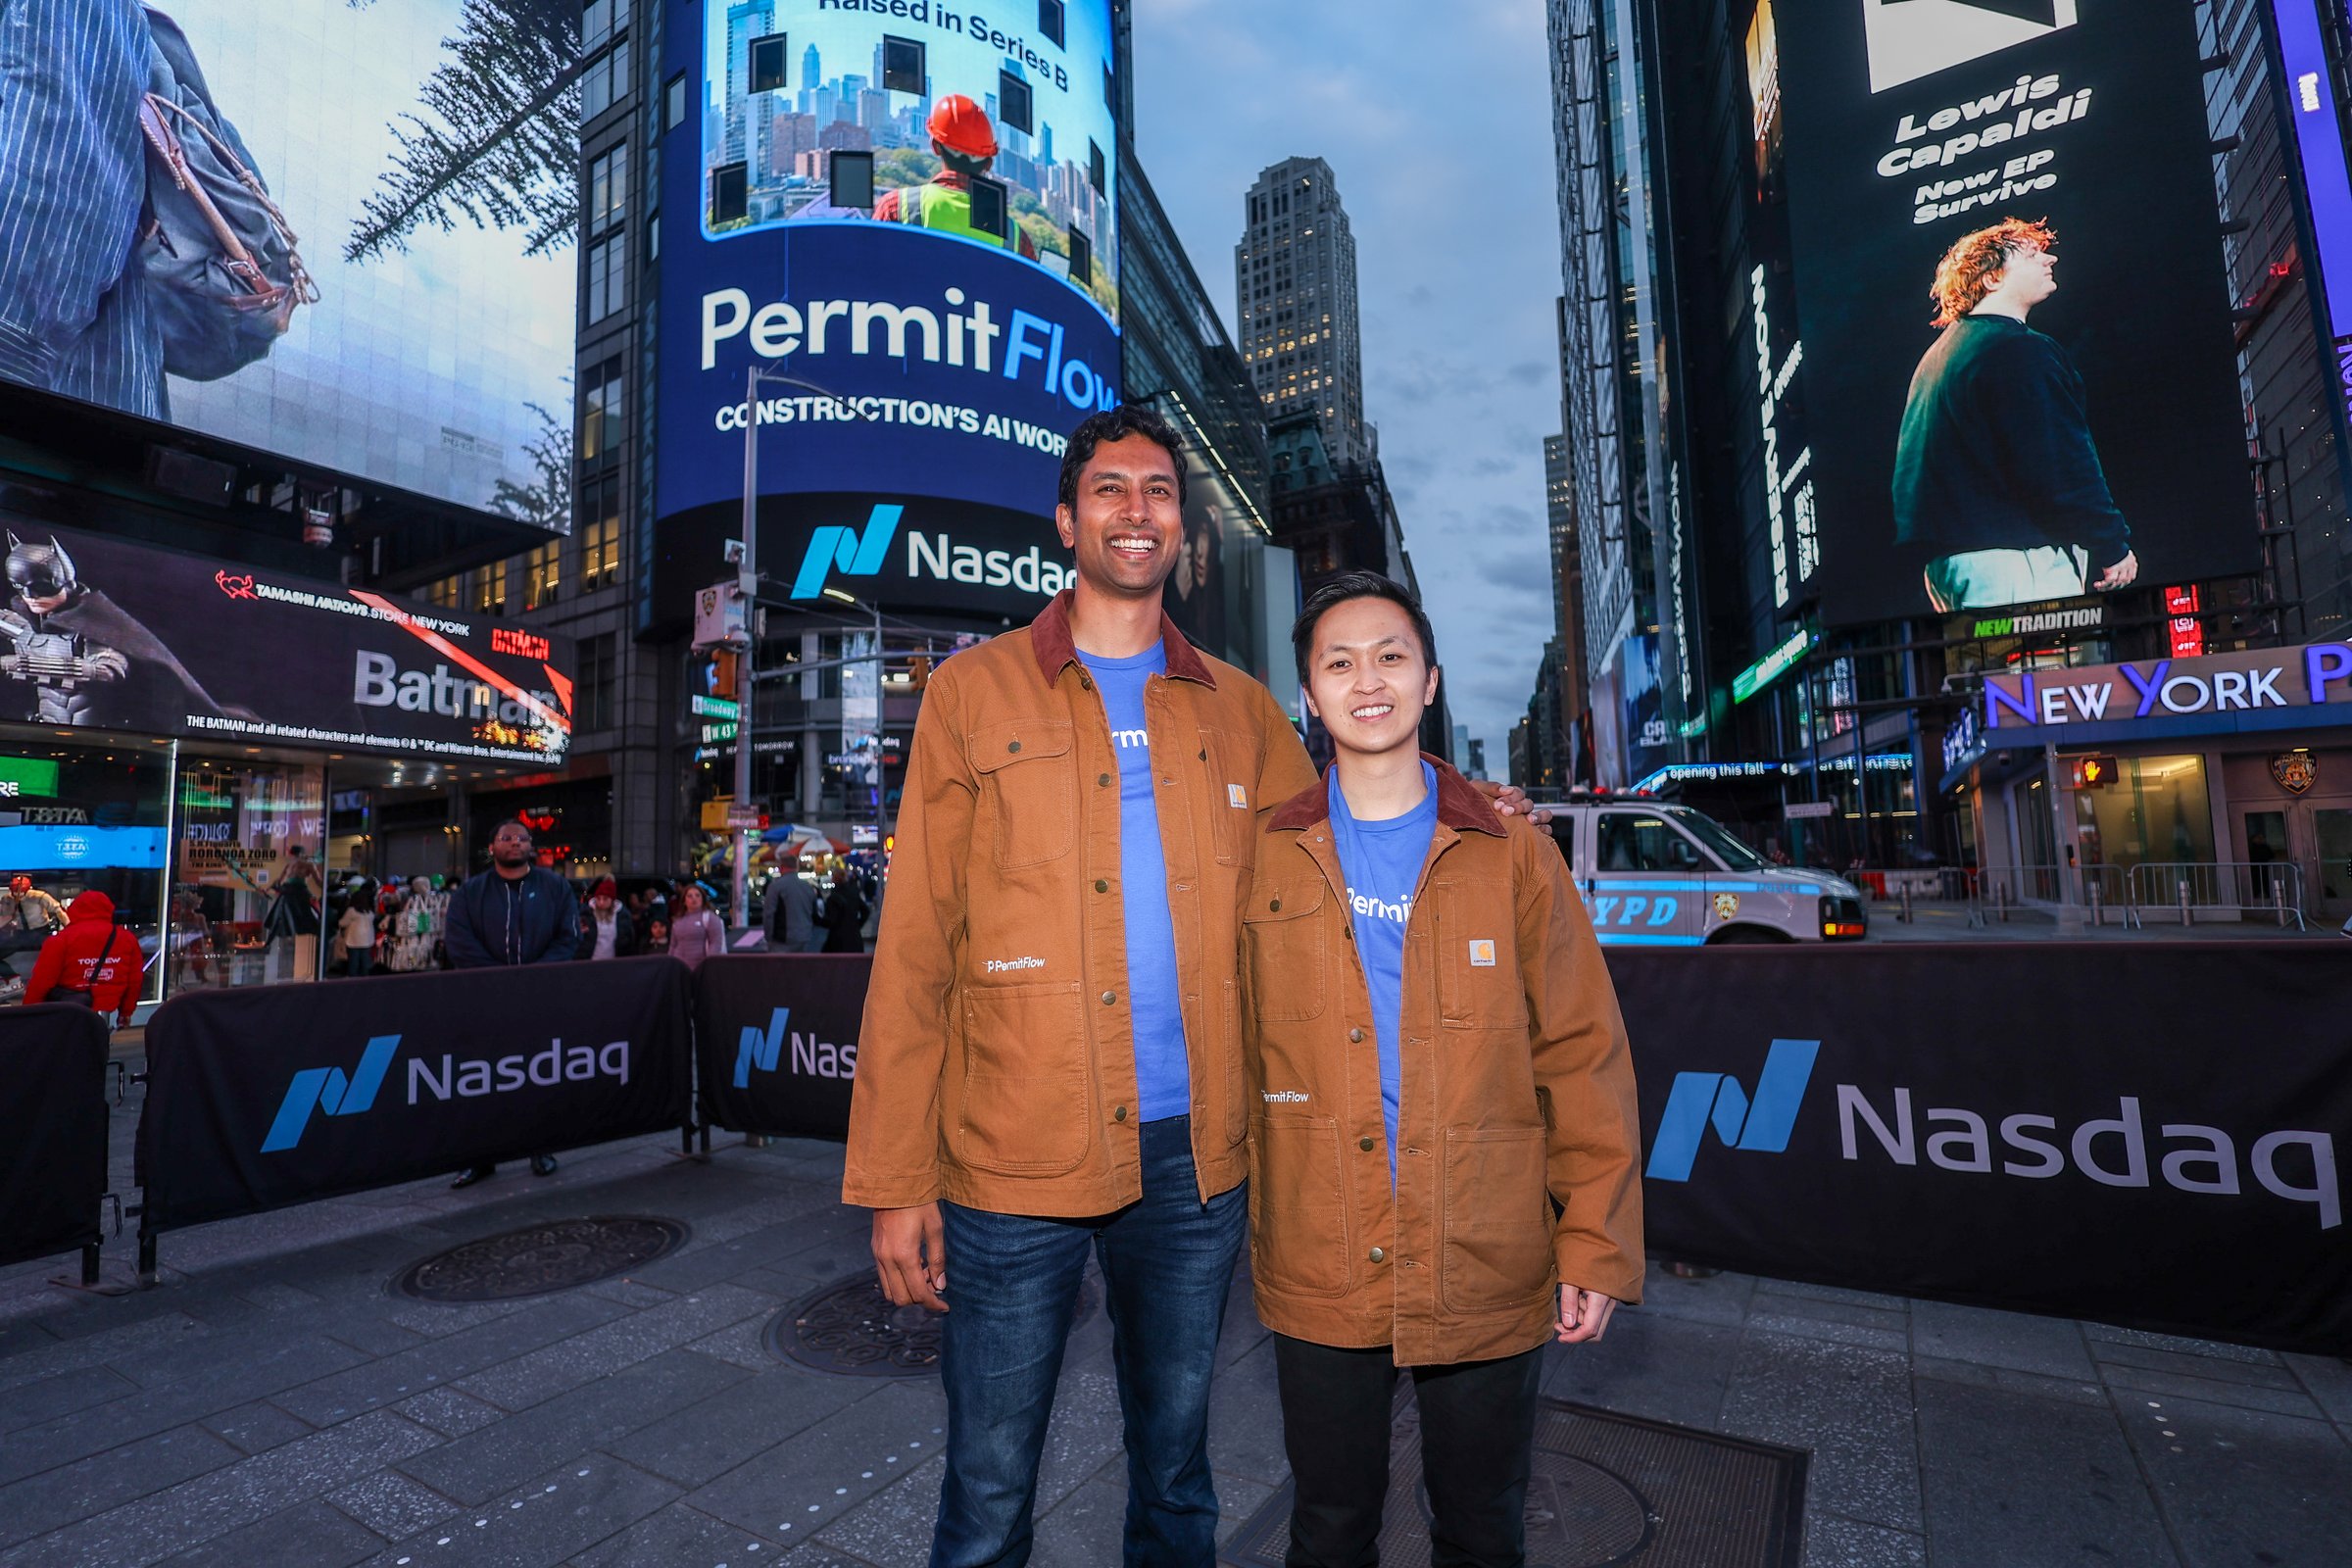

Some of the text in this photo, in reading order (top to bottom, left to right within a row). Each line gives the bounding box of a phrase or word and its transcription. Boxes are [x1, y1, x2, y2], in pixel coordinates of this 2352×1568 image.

[936, 4, 962, 33] in
[969, 16, 1051, 79] Series
[1055, 63, 1069, 93] B
[1876, 88, 2093, 177] Capaldi
[1894, 74, 2060, 144] Lewis
[1913, 173, 2058, 224] Survive
[1914, 149, 2055, 206] New EP
[982, 414, 1011, 441] AI
[1012, 419, 1069, 459] WOR
[256, 583, 315, 607] TAMASHII
[370, 608, 410, 625] STORE
[411, 614, 437, 630] NEW
[439, 619, 470, 637] YORK
[353, 649, 558, 725] Batman
[703, 700, 736, 720] Broadway
[186, 714, 206, 728] THE
[207, 716, 246, 732] BATMAN
[246, 722, 264, 734] and
[265, 723, 276, 735] all
[277, 725, 308, 738] related
[308, 729, 349, 743] characters
[349, 732, 366, 744] and
[366, 734, 400, 748] elements
[435, 742, 449, 753] and
[449, 742, 473, 755] Warner
[711, 726, 719, 740] W
[721, 724, 731, 738] 43
[1670, 766, 1717, 782] opening
[1719, 762, 1742, 777] this
[1744, 760, 1765, 776] fall
[1347, 887, 1414, 923] Permi
[1585, 896, 1679, 927] YPD
[78, 956, 122, 966] TOPEW
[995, 956, 1046, 972] PermitFlow
[407, 1037, 632, 1106] Nasdaq
[1836, 1083, 2343, 1230] Nasdaq
